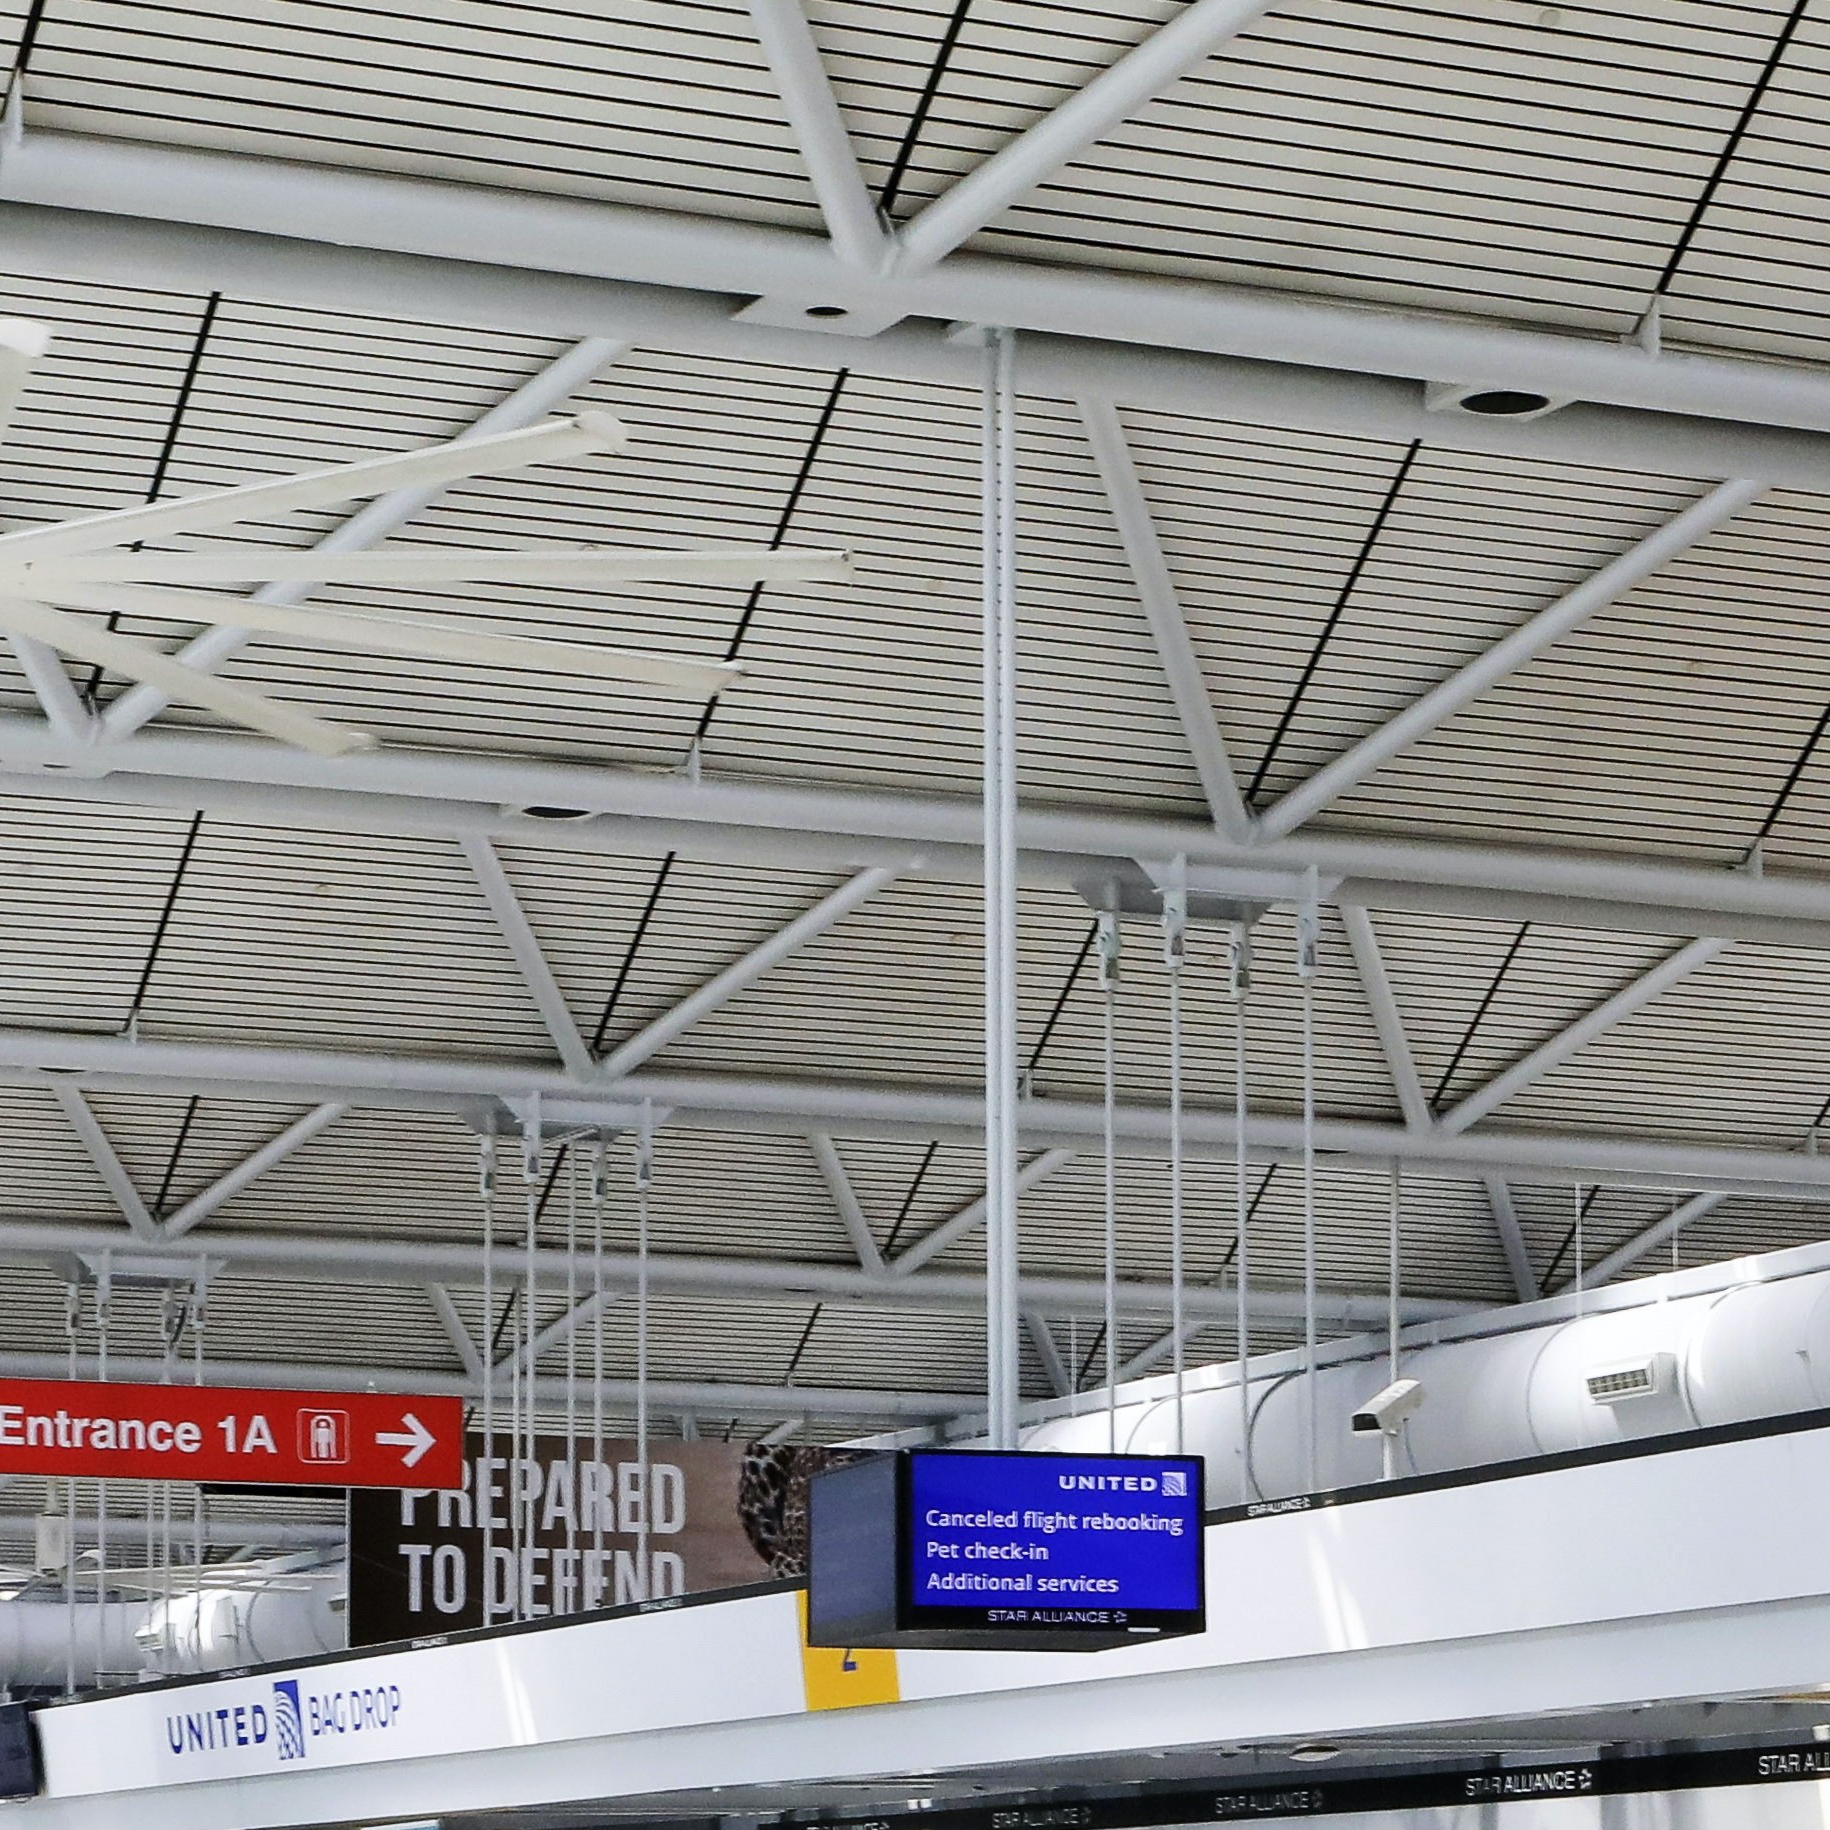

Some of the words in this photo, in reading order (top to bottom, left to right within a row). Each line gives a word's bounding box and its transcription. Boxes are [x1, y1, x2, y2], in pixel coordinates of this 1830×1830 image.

[217, 1415, 278, 1454] 1A
[1058, 1475, 1158, 1492] UNITED
[926, 1509, 1018, 1528] Canceled
[1023, 1510, 1077, 1534] flight
[1082, 1512, 1184, 1536] rebooking
[926, 1541, 959, 1559] Pet
[964, 1541, 1049, 1560] check-in
[398, 1544, 468, 1614] TO
[485, 1547, 686, 1616] DEFEND
[926, 1571, 1032, 1592] Additional
[1037, 1575, 1120, 1593] services
[987, 1609, 1028, 1623] STAR
[1031, 1610, 1111, 1623] ALLIANCE
[166, 1704, 268, 1754] UNITED
[309, 1692, 346, 1737] BAG
[350, 1684, 401, 1731] DROP
[1758, 1753, 1801, 1776] STAR
[1465, 1776, 1502, 1797] STAR
[1503, 1770, 1576, 1793] ALLIANCE
[1214, 1794, 1247, 1814] STAR
[1249, 1790, 1310, 1812] ALLIANCE
[1024, 1808, 1079, 1828] ALLIANCE
